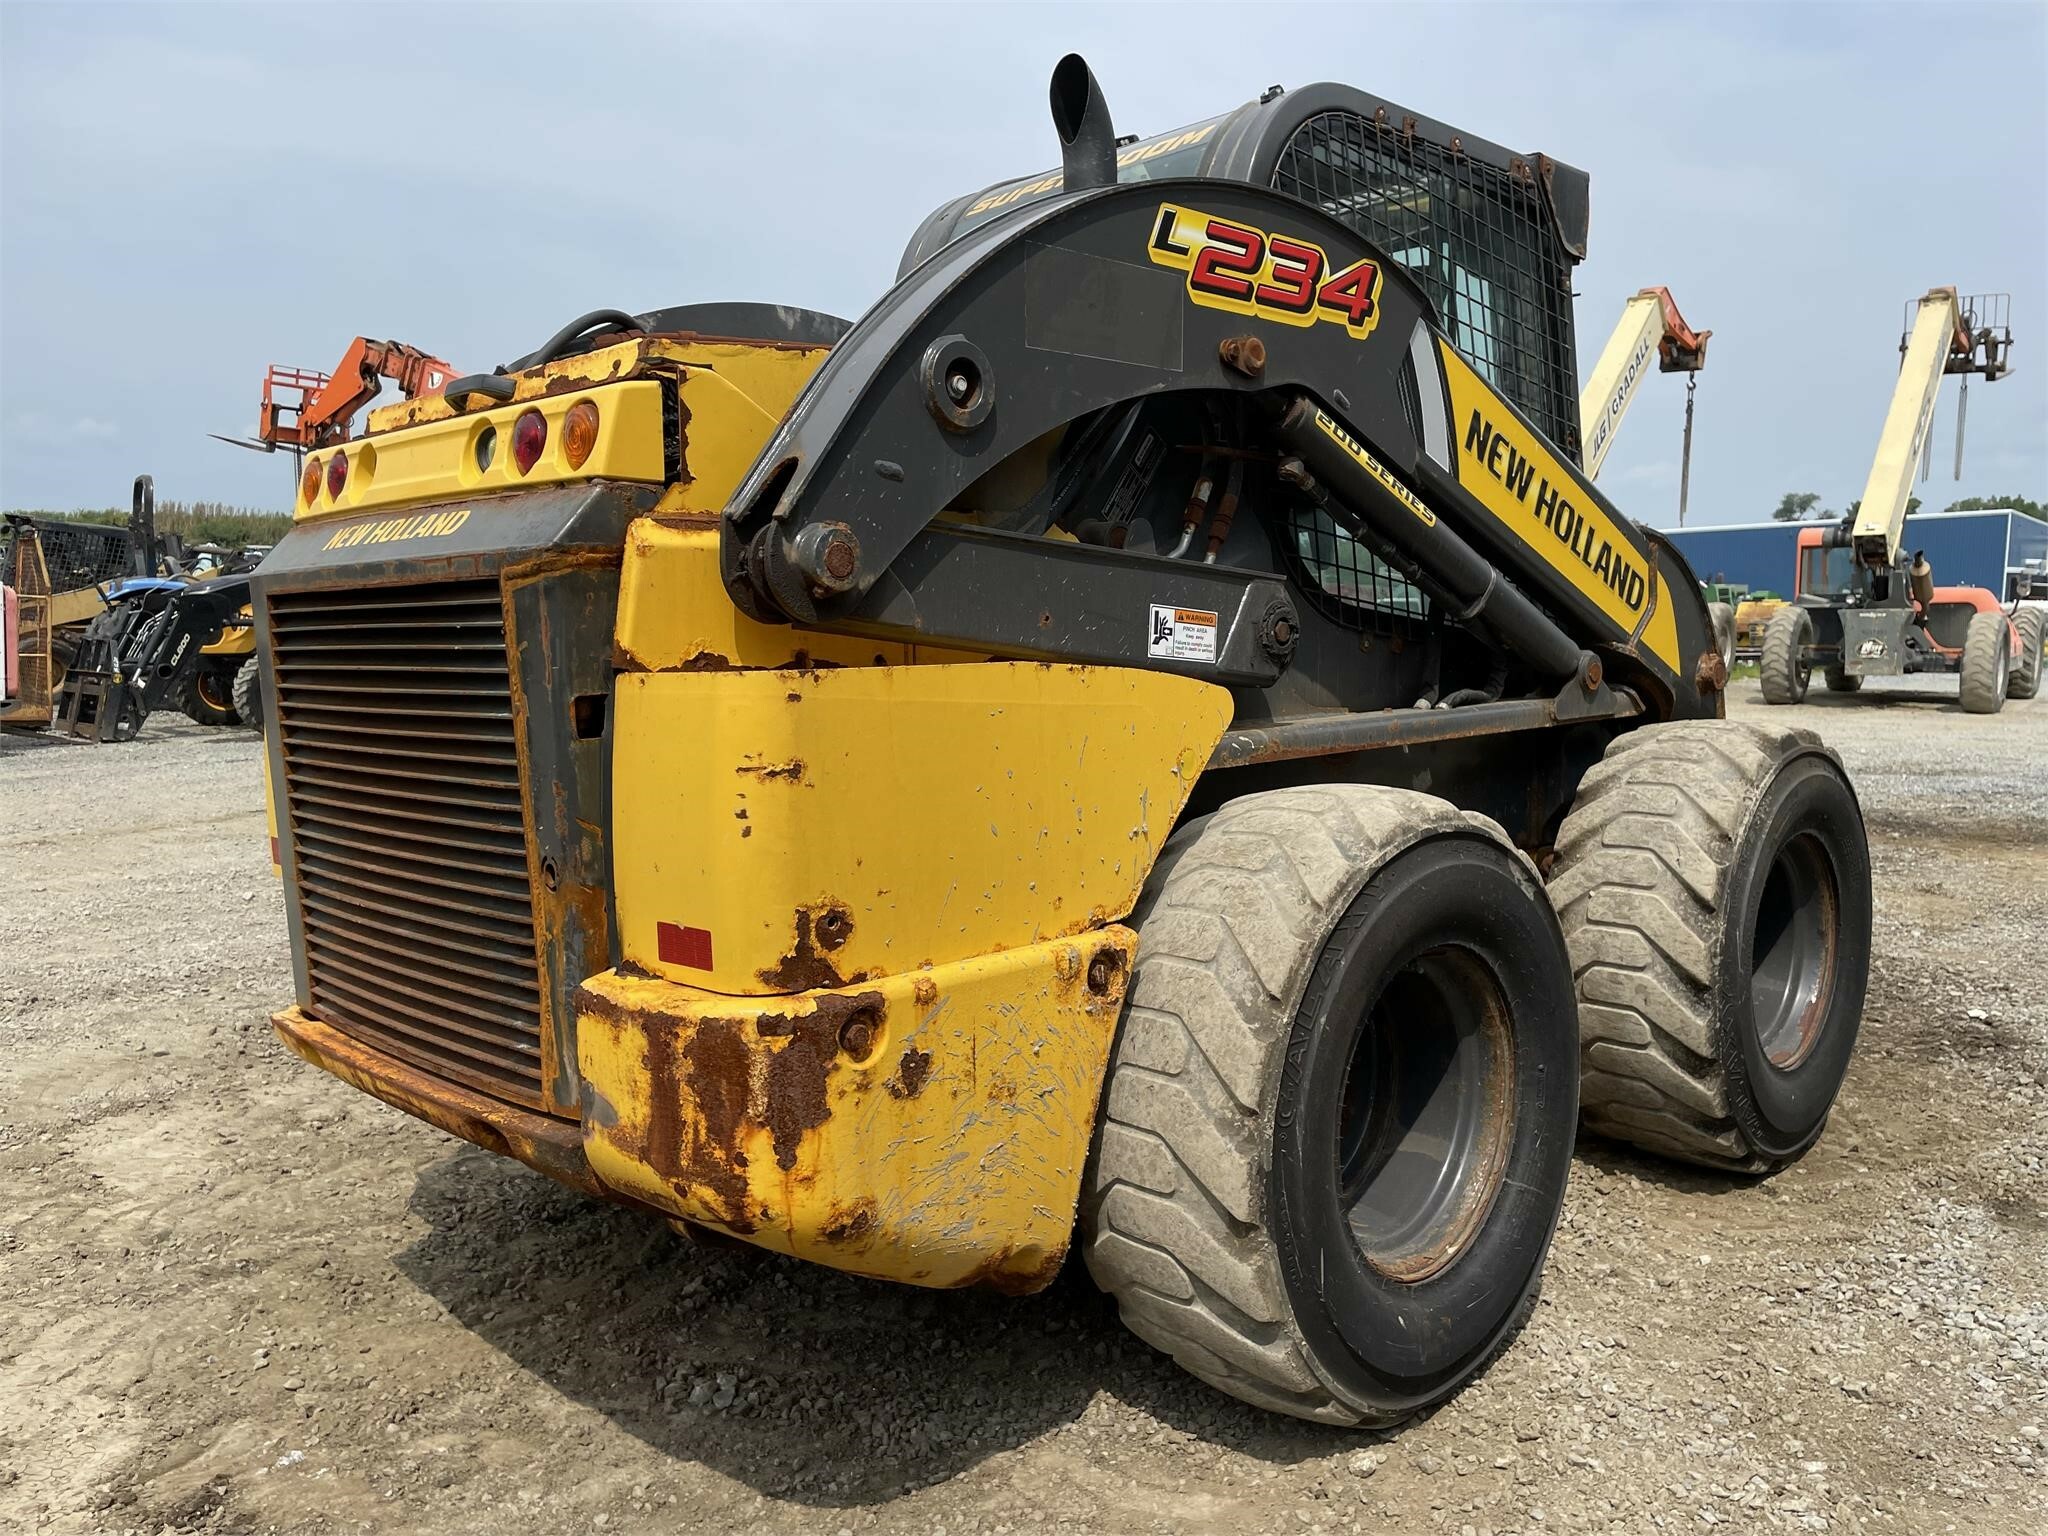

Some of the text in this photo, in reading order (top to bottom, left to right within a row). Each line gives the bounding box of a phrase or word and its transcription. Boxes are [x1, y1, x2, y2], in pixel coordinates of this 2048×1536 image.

[1117, 124, 1216, 167] OOM
[1150, 206, 1380, 331] L234
[1592, 337, 1650, 460] JLG GRADALL
[1316, 411, 1436, 523] 200 SERIES
[1464, 408, 1645, 612] NEW HOLLAND
[321, 510, 471, 550] NEW HOLLAND
[1185, 613, 1214, 624] WARNING
